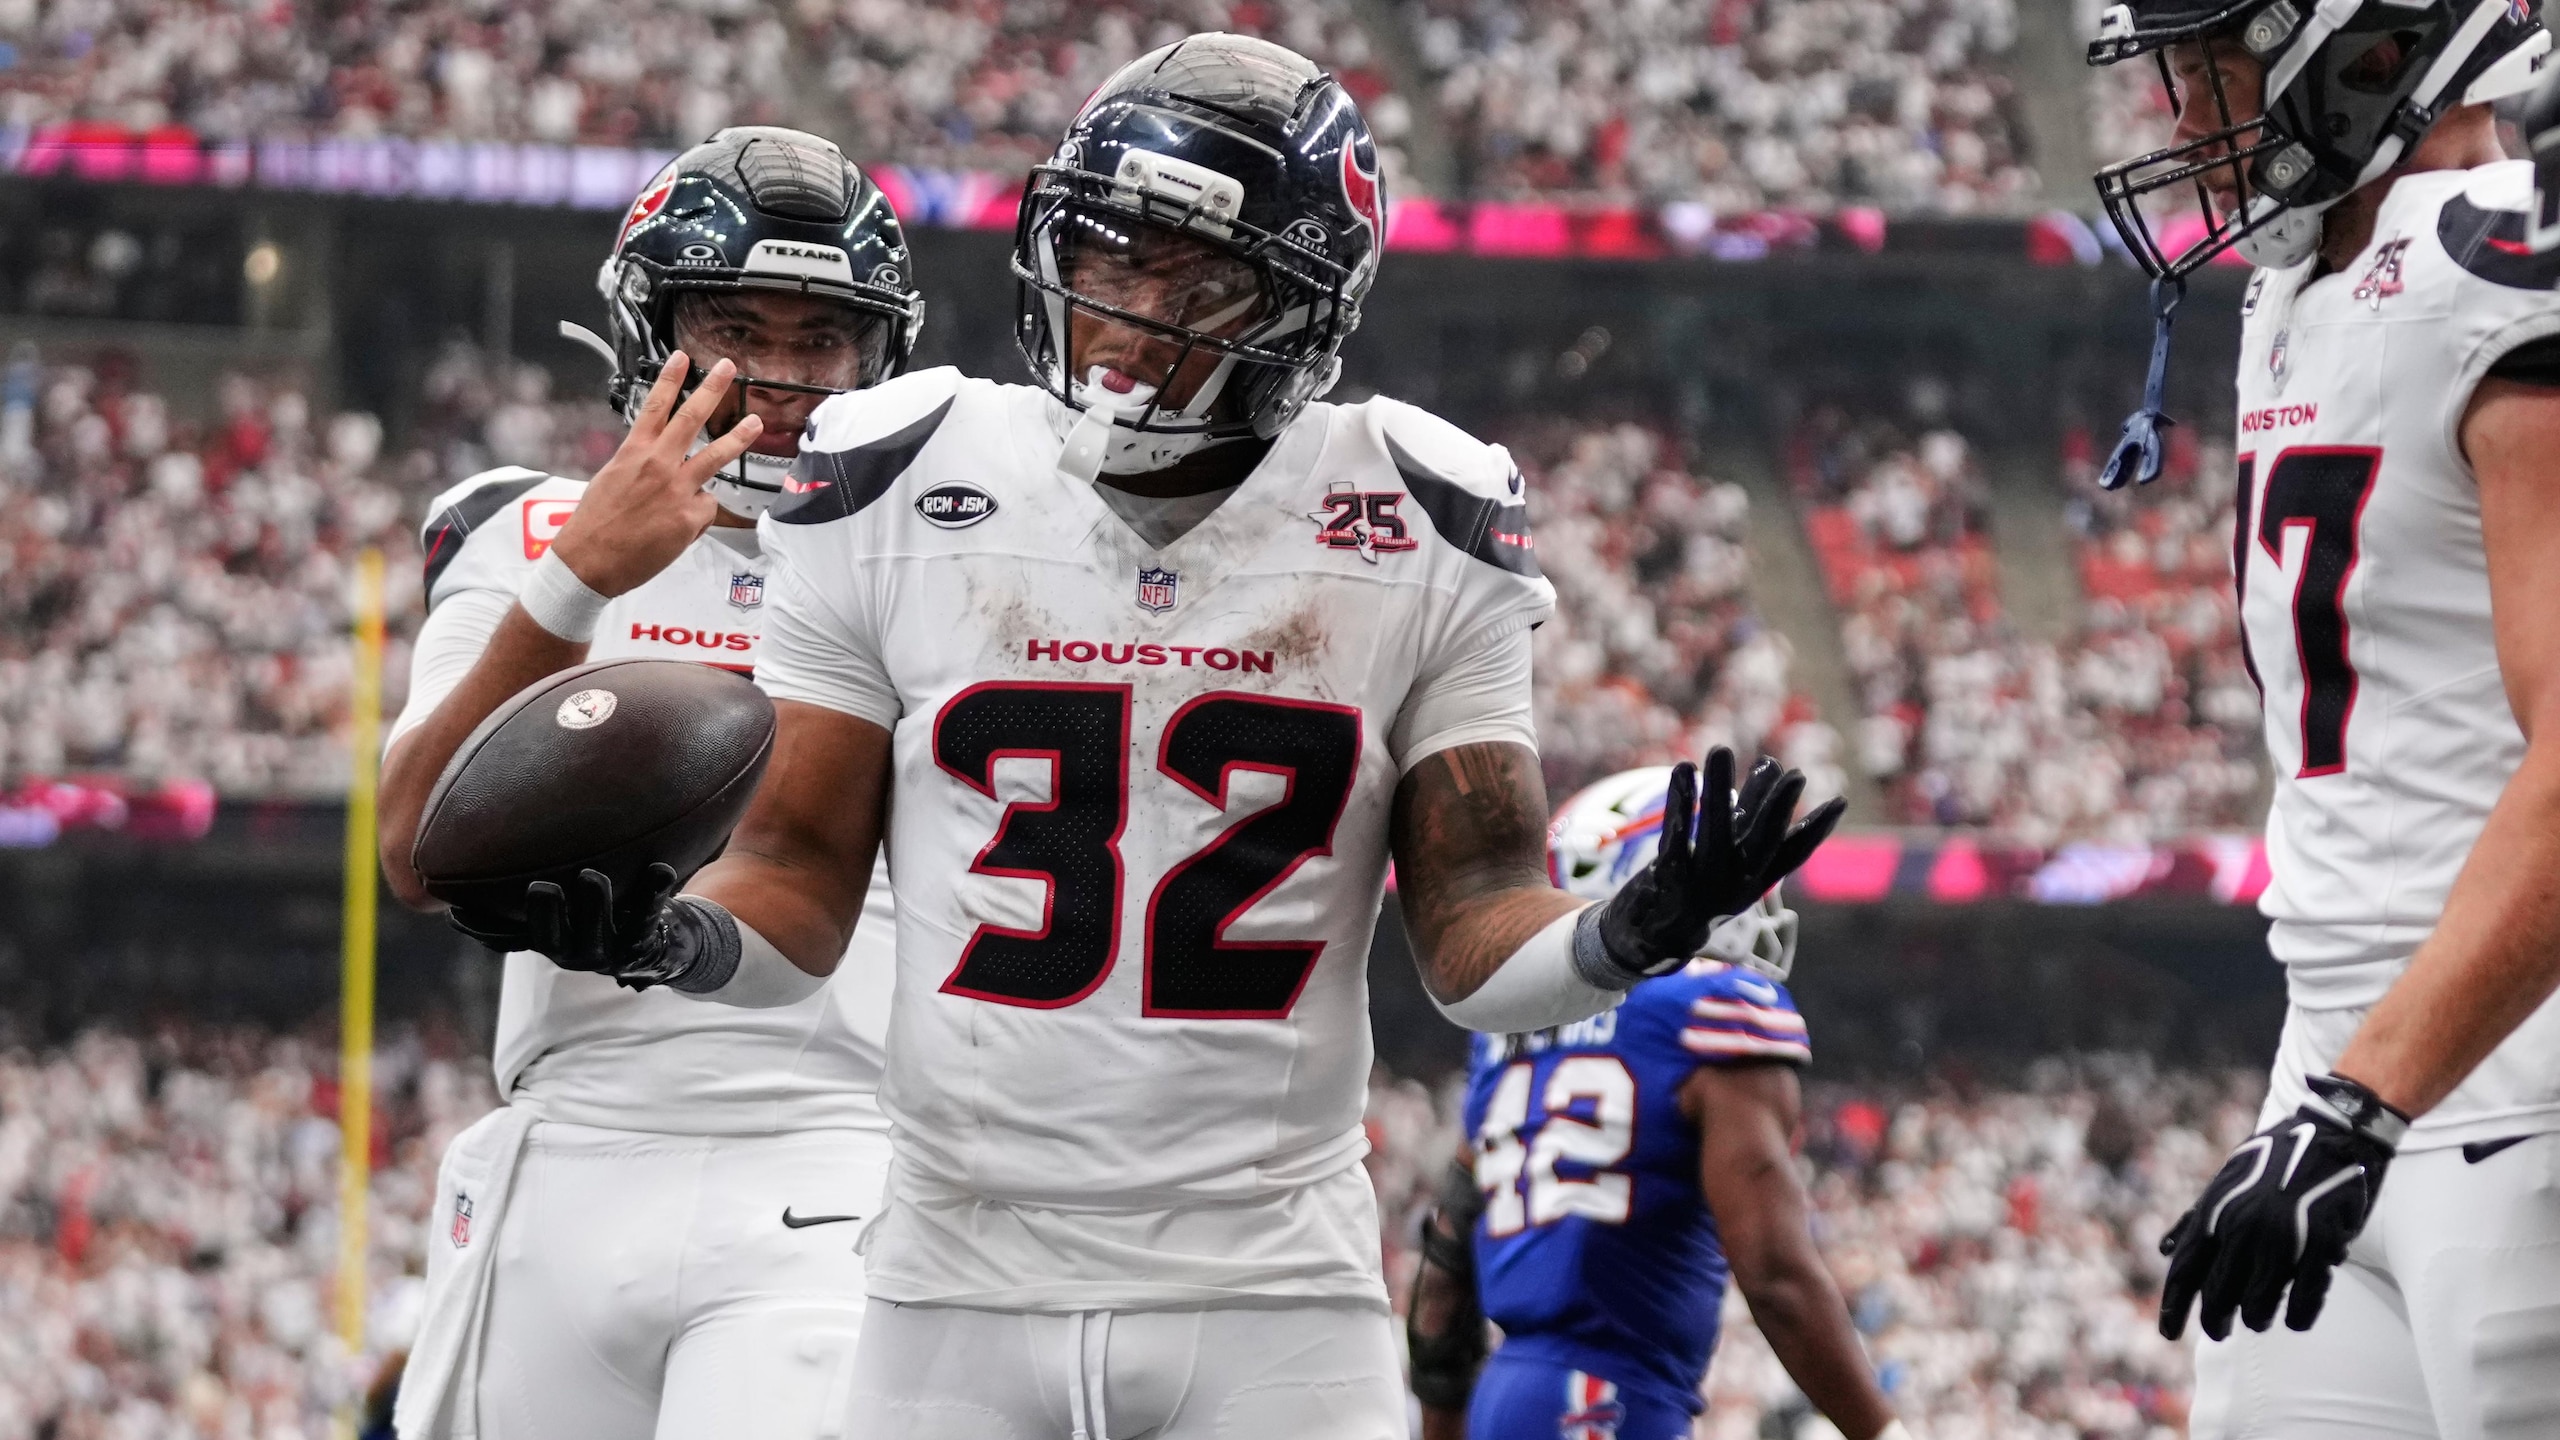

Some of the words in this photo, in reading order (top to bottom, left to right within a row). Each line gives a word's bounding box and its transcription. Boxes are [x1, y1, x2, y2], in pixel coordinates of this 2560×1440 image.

[1157, 171, 1203, 191] TEXANS
[762, 244, 843, 262] TEXANS
[1287, 232, 1329, 256] OAKLEY
[676, 258, 722, 267] OAKLEY
[2242, 403, 2317, 434] HOUSTON
[1323, 492, 1407, 550] 25
[733, 587, 759, 602] NFL
[1141, 585, 1172, 605] NFL
[631, 623, 761, 651] HOUS
[1028, 639, 1275, 673] HOUSTON
[932, 680, 1363, 1019] 32
[1473, 1055, 1638, 1238] 42
